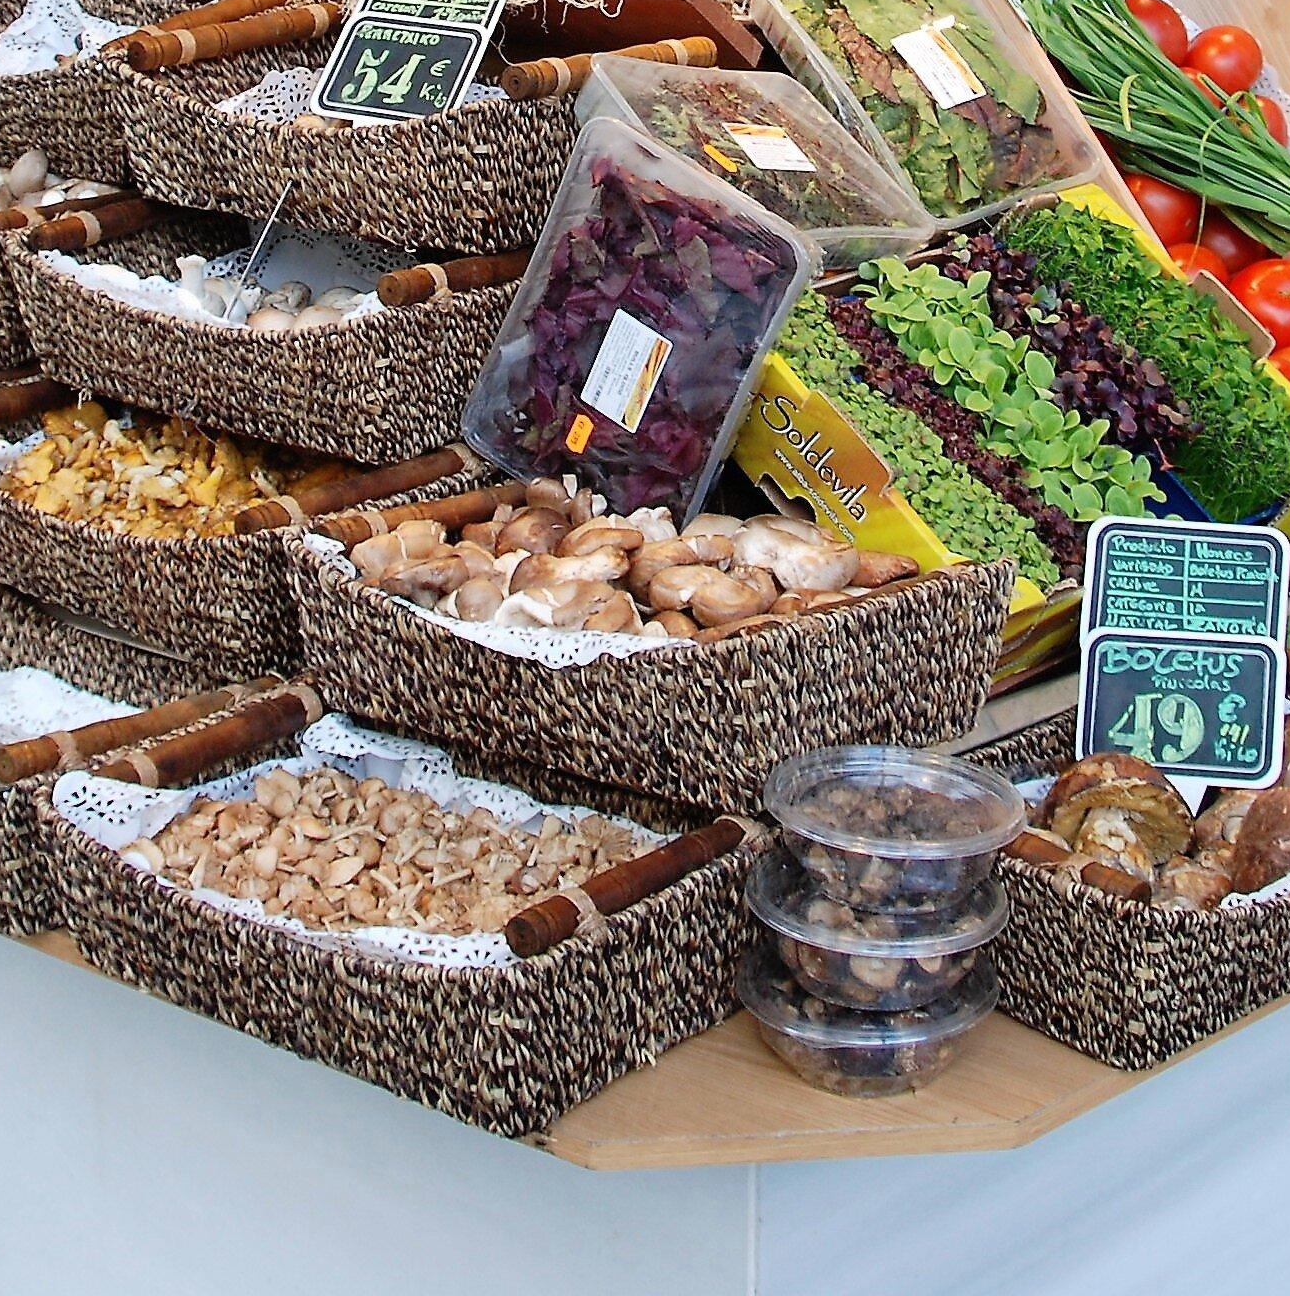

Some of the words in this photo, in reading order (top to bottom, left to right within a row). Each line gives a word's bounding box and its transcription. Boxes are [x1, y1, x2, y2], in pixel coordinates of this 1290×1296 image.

[340, 47, 426, 105] 54
[429, 58, 452, 78] €
[760, 395, 868, 523] Soldevila
[1110, 534, 1177, 555] Producto
[1108, 692, 1206, 764] 49
